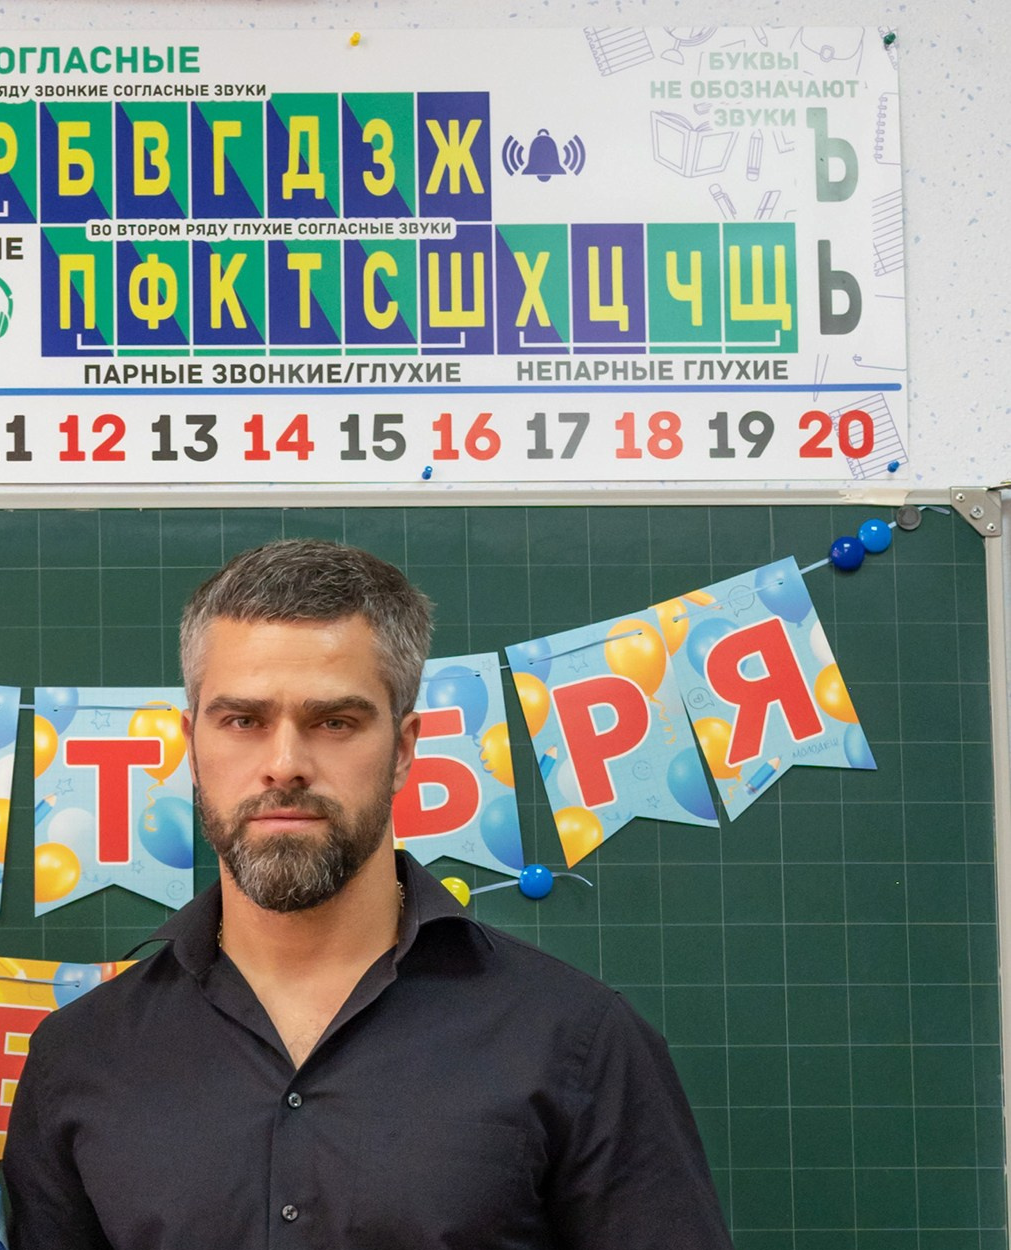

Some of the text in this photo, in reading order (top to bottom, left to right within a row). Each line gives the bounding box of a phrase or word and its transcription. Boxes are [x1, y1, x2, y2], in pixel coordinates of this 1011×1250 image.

[710, 52, 798, 70] БУКВЫ
[35, 86, 108, 98] ЗВОНКИЕ
[114, 85, 209, 97] СОГЛАСНЫЕ
[215, 85, 266, 97] ЗВУКИ
[651, 80, 858, 98] НЕ ОБОЗНАЧАЮТ
[715, 108, 795, 126] ЗВУКИ
[58, 122, 94, 195] Б
[134, 122, 170, 195] В
[213, 122, 241, 195] Г
[283, 116, 324, 198] Д
[363, 119, 394, 195] З
[427, 120, 483, 193] Ж
[807, 107, 858, 202] Ъ
[91, 223, 450, 236] ВО ВТОРОМ РЯДУ ГЛУХИЕ СОГЛАСНЫЕ ЗВУКИ
[60, 248, 791, 330] П Ф К Т С Ш Х Ц Ч Щ
[818, 240, 862, 335] Ь
[85, 362, 461, 385] ПАРНЫЕ ЗВОНКИЕ/ГЛУХИЕ
[518, 360, 788, 381] НЕПАРНЫЕ ГЛУХИЕ
[59, 414, 126, 461] 12
[152, 414, 218, 462] 13
[244, 414, 315, 461] 14
[340, 413, 406, 461] 15
[432, 411, 501, 461] 16
[527, 412, 590, 459] 17
[615, 411, 683, 459] 18
[709, 411, 775, 458] 19
[799, 410, 874, 459] 20
